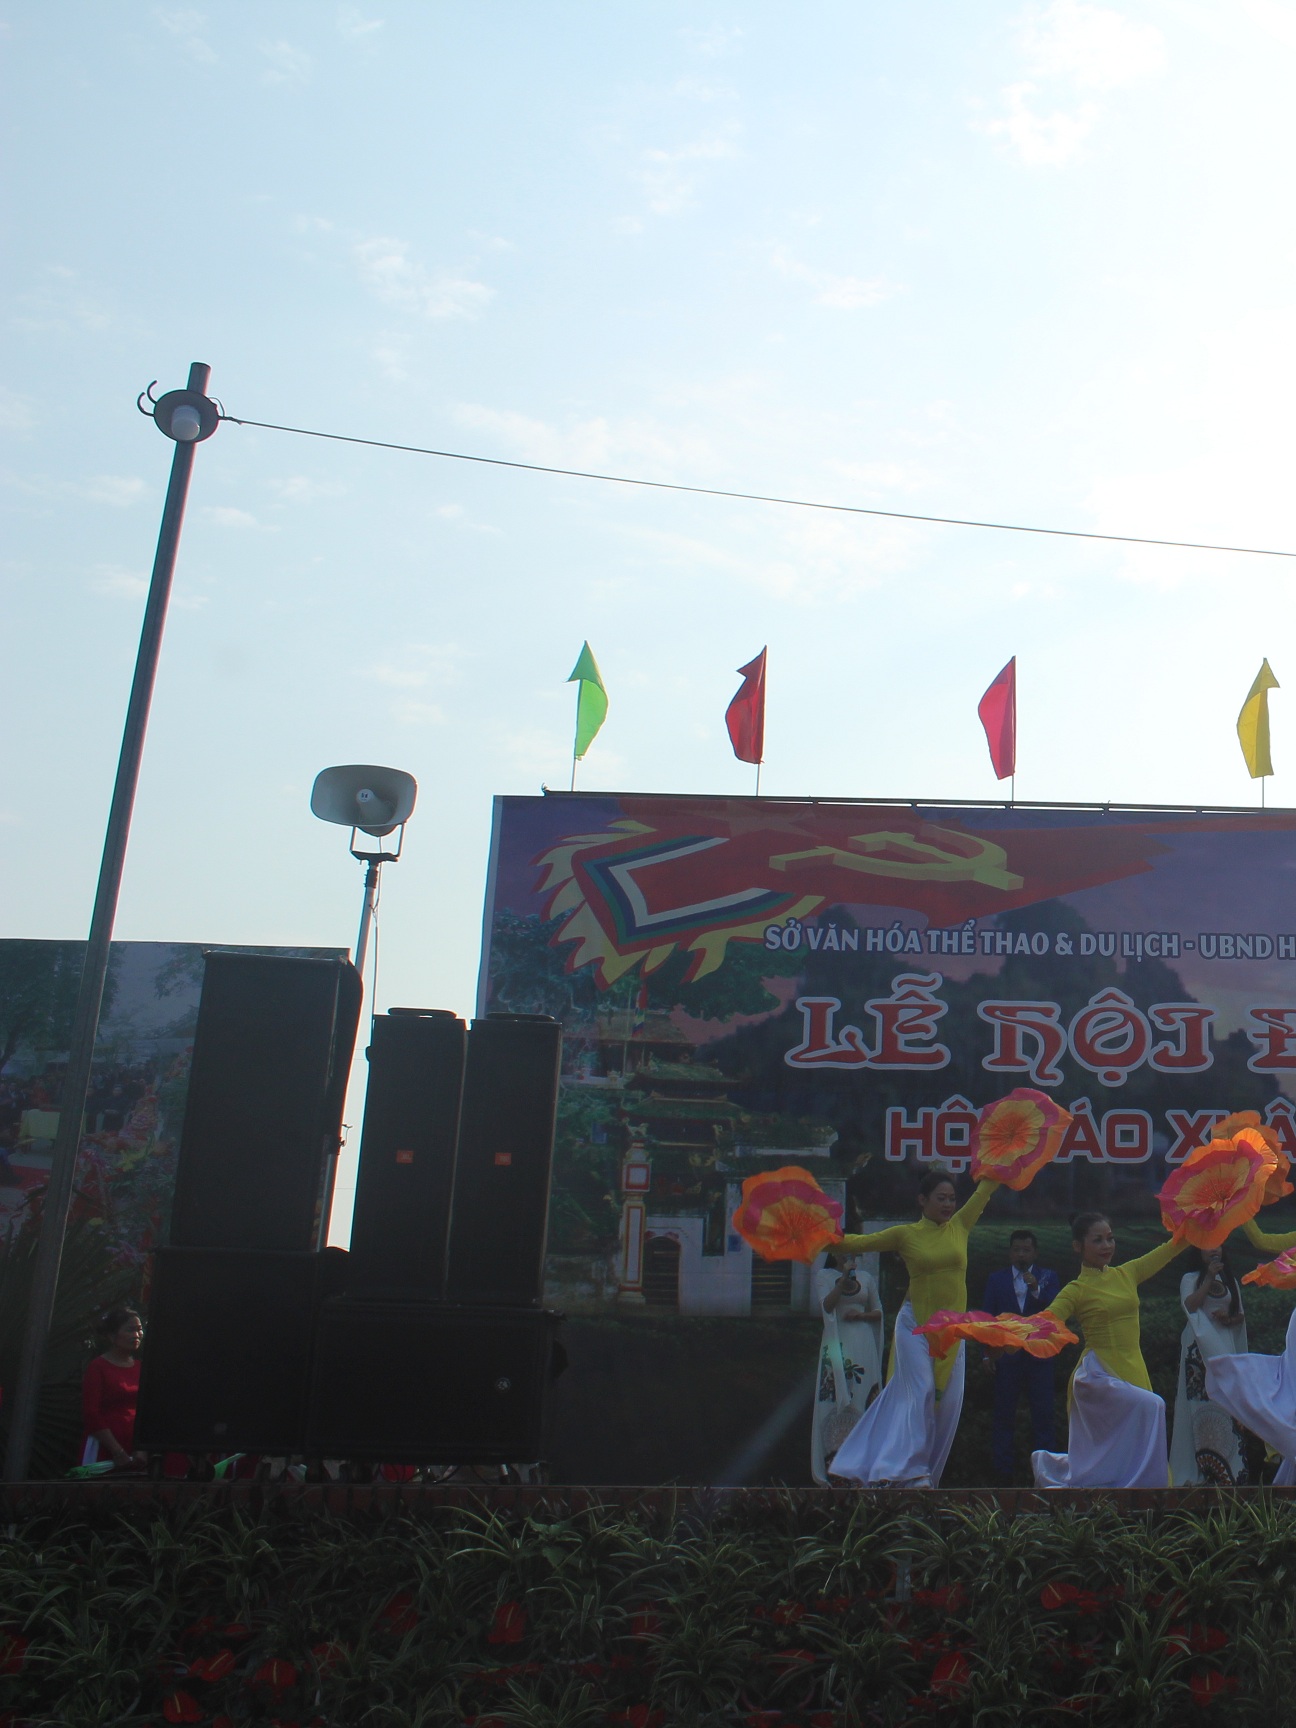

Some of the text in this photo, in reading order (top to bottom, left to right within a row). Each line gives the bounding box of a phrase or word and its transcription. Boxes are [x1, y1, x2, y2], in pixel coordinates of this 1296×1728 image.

[763, 917, 803, 953] SỞ
[806, 922, 860, 952] VĂN
[866, 922, 922, 954] HÓA
[926, 918, 977, 955] THỂ
[980, 930, 1050, 956] THAO
[1054, 931, 1074, 956] &
[1079, 932, 1116, 957] DU
[1122, 932, 1180, 964] LỊCH
[1200, 933, 1273, 959] UBND
[785, 973, 951, 1070] LỄ
[886, 1095, 977, 1173] HỘ
[1054, 1097, 1154, 1164] ÁO
